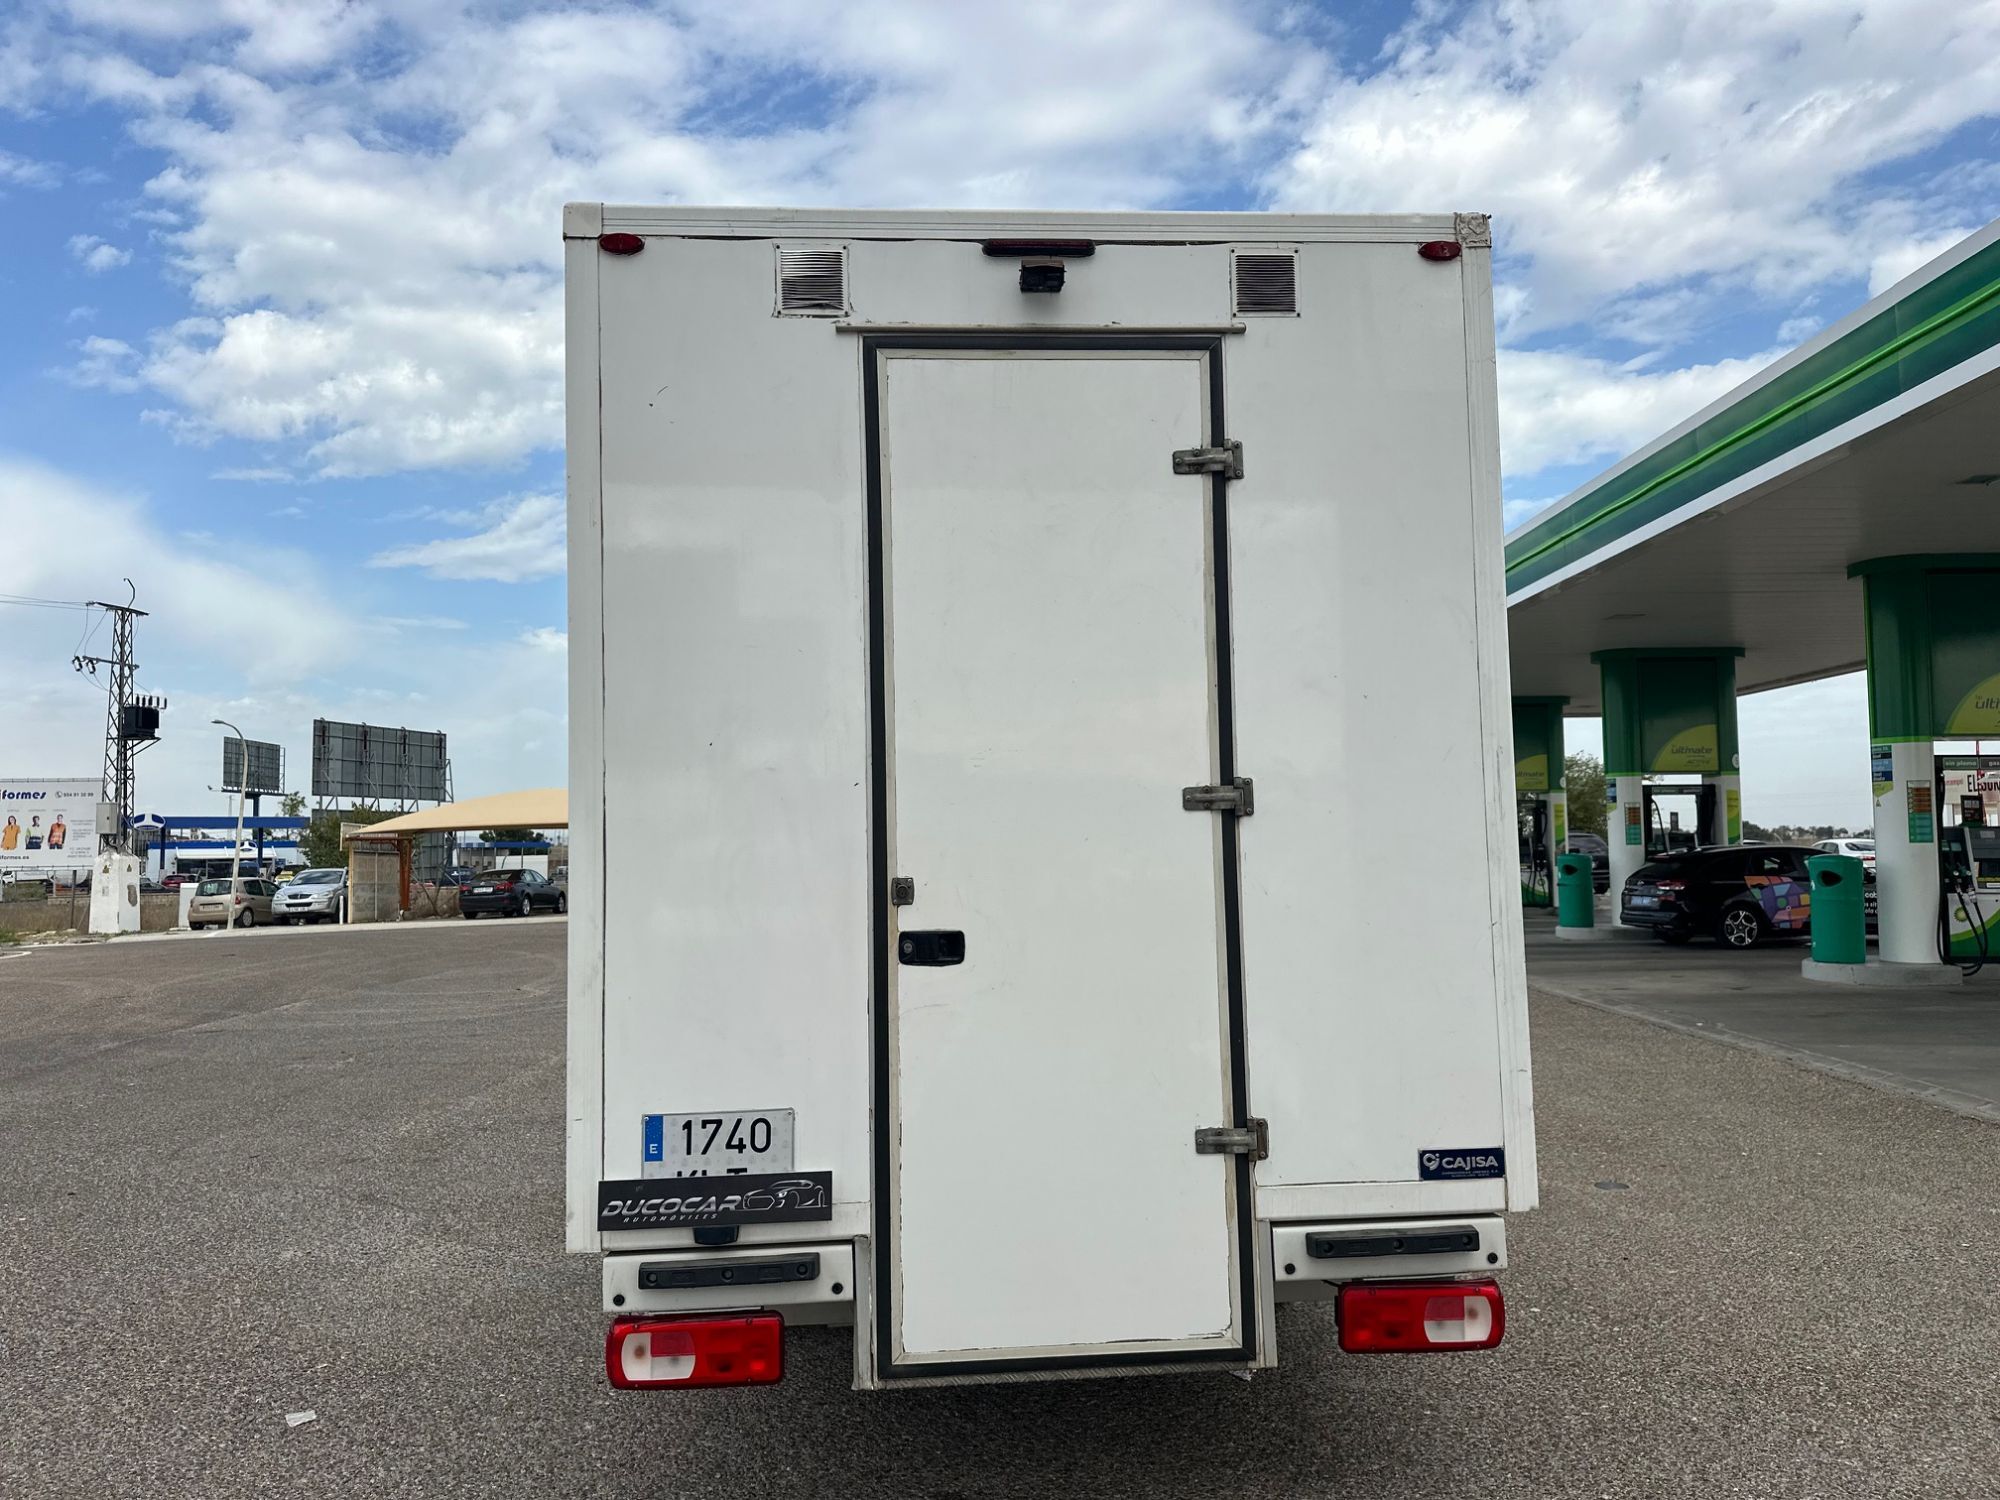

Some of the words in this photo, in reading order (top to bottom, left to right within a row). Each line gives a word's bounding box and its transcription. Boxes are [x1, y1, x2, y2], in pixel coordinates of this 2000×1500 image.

[0, 789, 47, 799] formes
[682, 1117, 772, 1156] 1740
[649, 1143, 658, 1154] E
[1441, 1155, 1499, 1171] CAJISA
[601, 1195, 742, 1217] DUCOCAR
